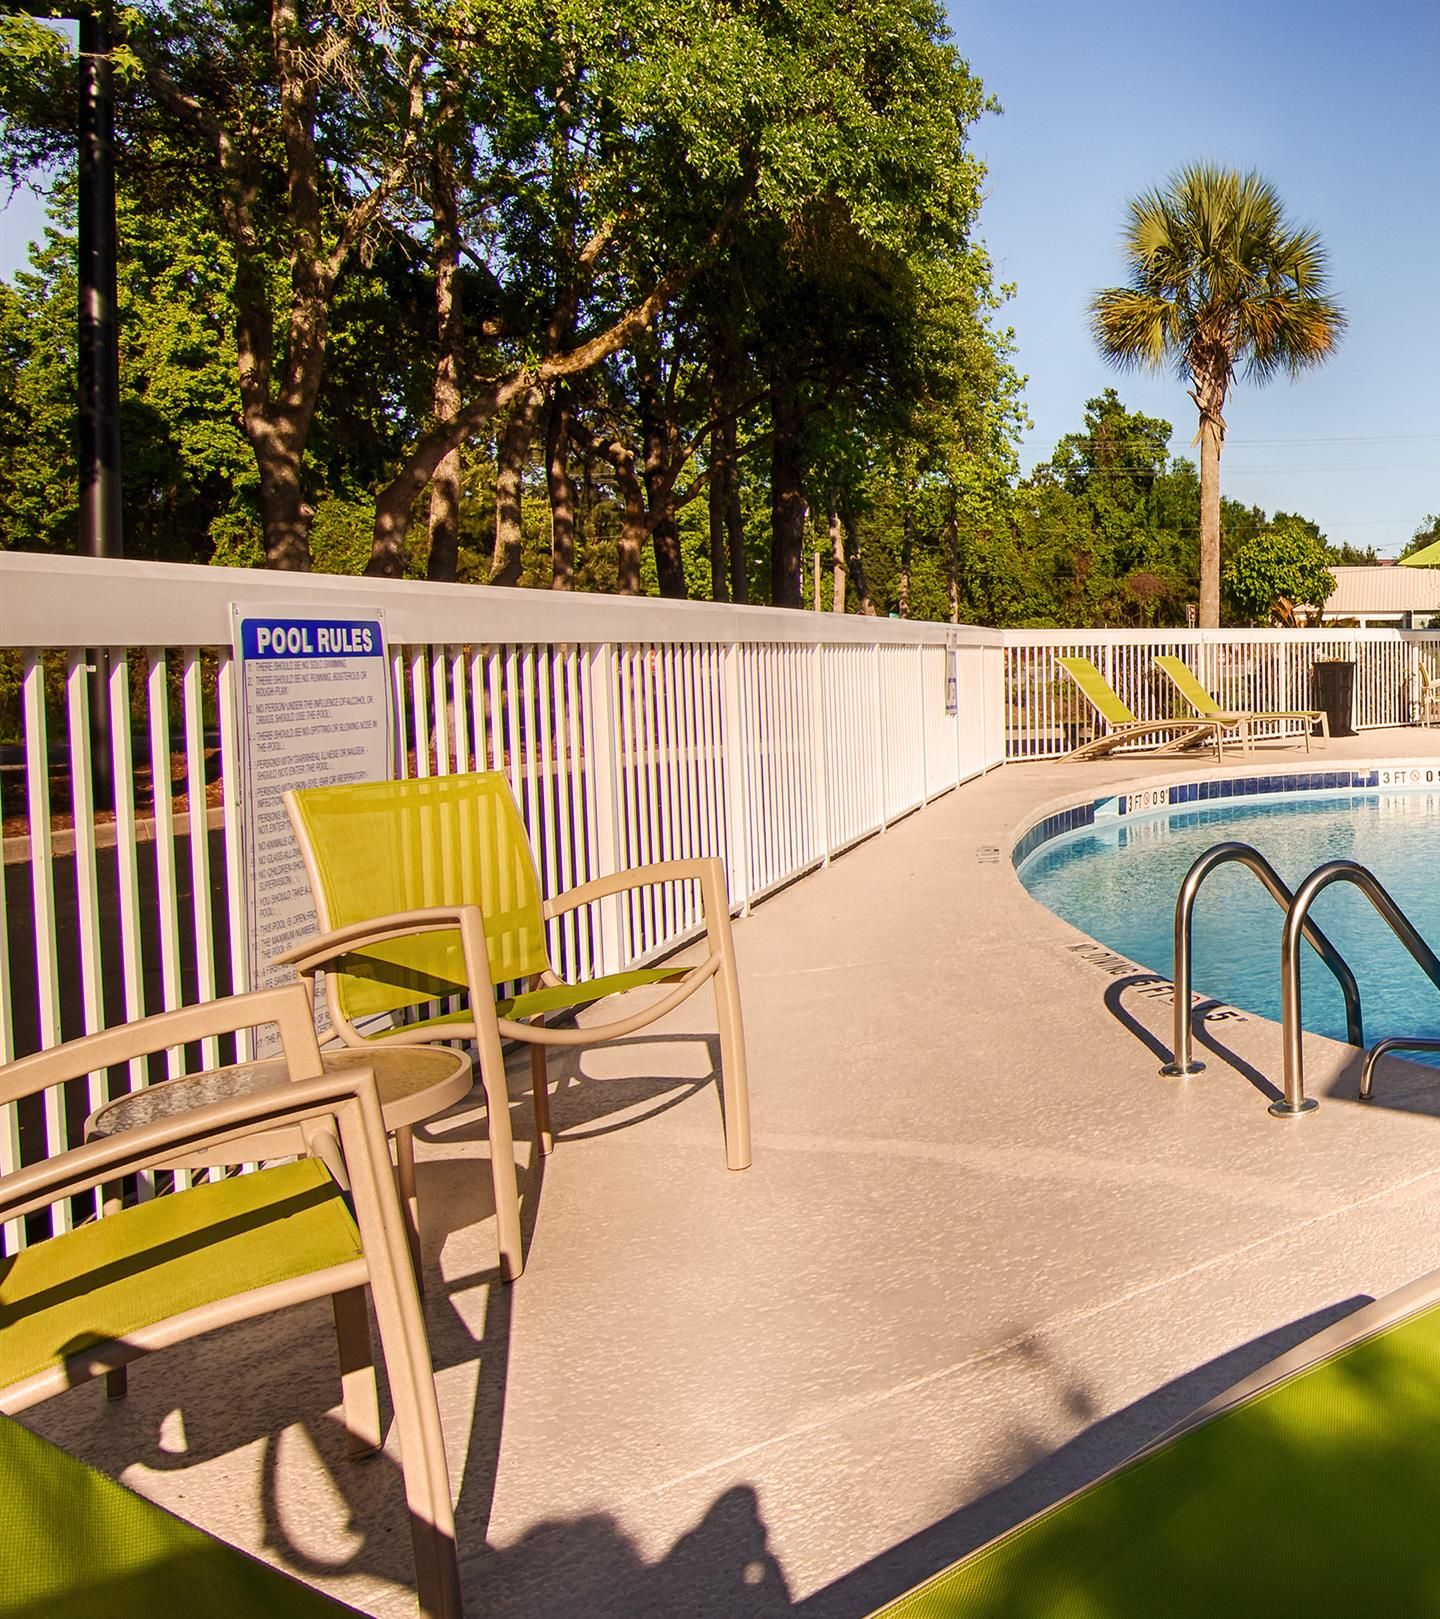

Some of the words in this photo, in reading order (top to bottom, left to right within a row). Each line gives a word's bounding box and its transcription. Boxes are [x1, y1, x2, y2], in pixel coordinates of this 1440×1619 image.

[256, 627, 314, 654] POOL
[317, 628, 373, 653] RULES
[1383, 772, 1390, 784] 3
[1394, 771, 1407, 784] FT
[1128, 795, 1133, 812] 3
[1134, 794, 1142, 809] FT
